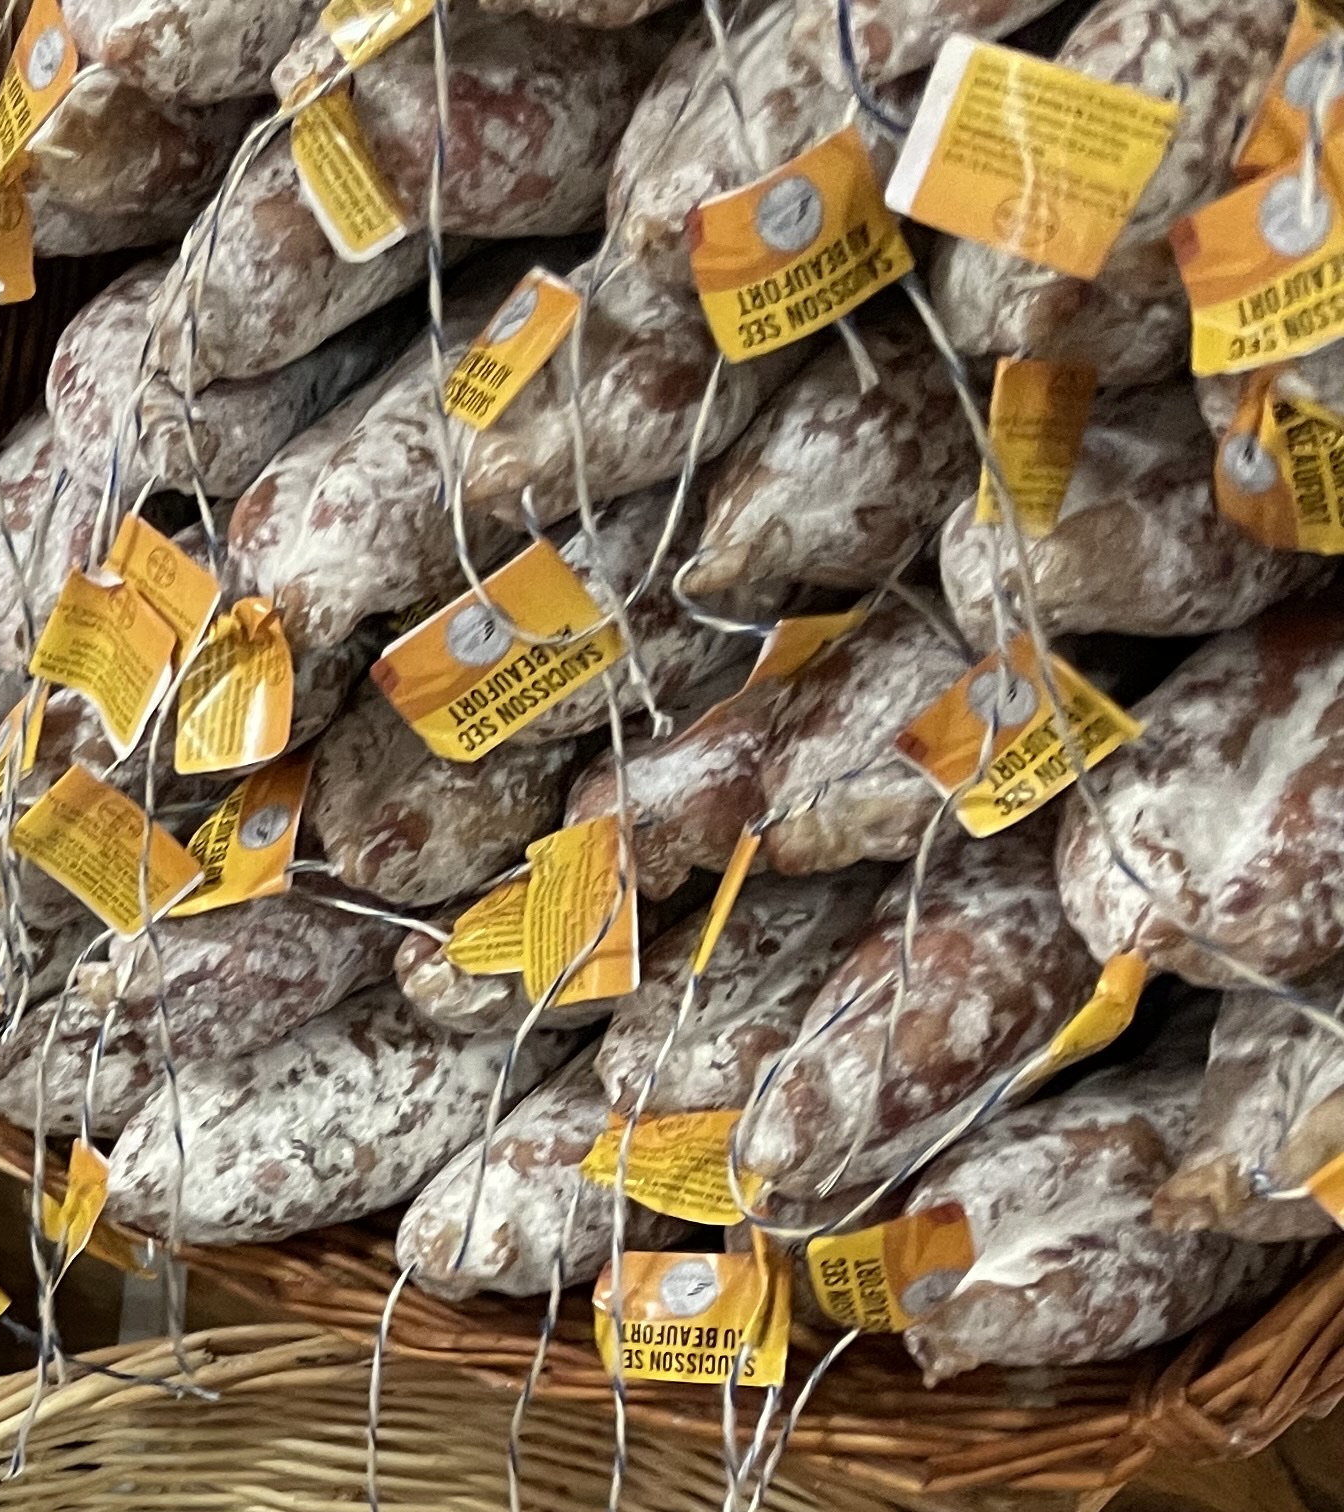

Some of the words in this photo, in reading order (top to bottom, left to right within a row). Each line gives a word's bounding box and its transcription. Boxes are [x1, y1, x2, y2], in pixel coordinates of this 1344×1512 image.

[737, 313, 783, 349] SEC
[447, 644, 551, 728] BEAUFORT
[495, 641, 605, 727] SAUCISSON
[457, 715, 499, 754] SEC
